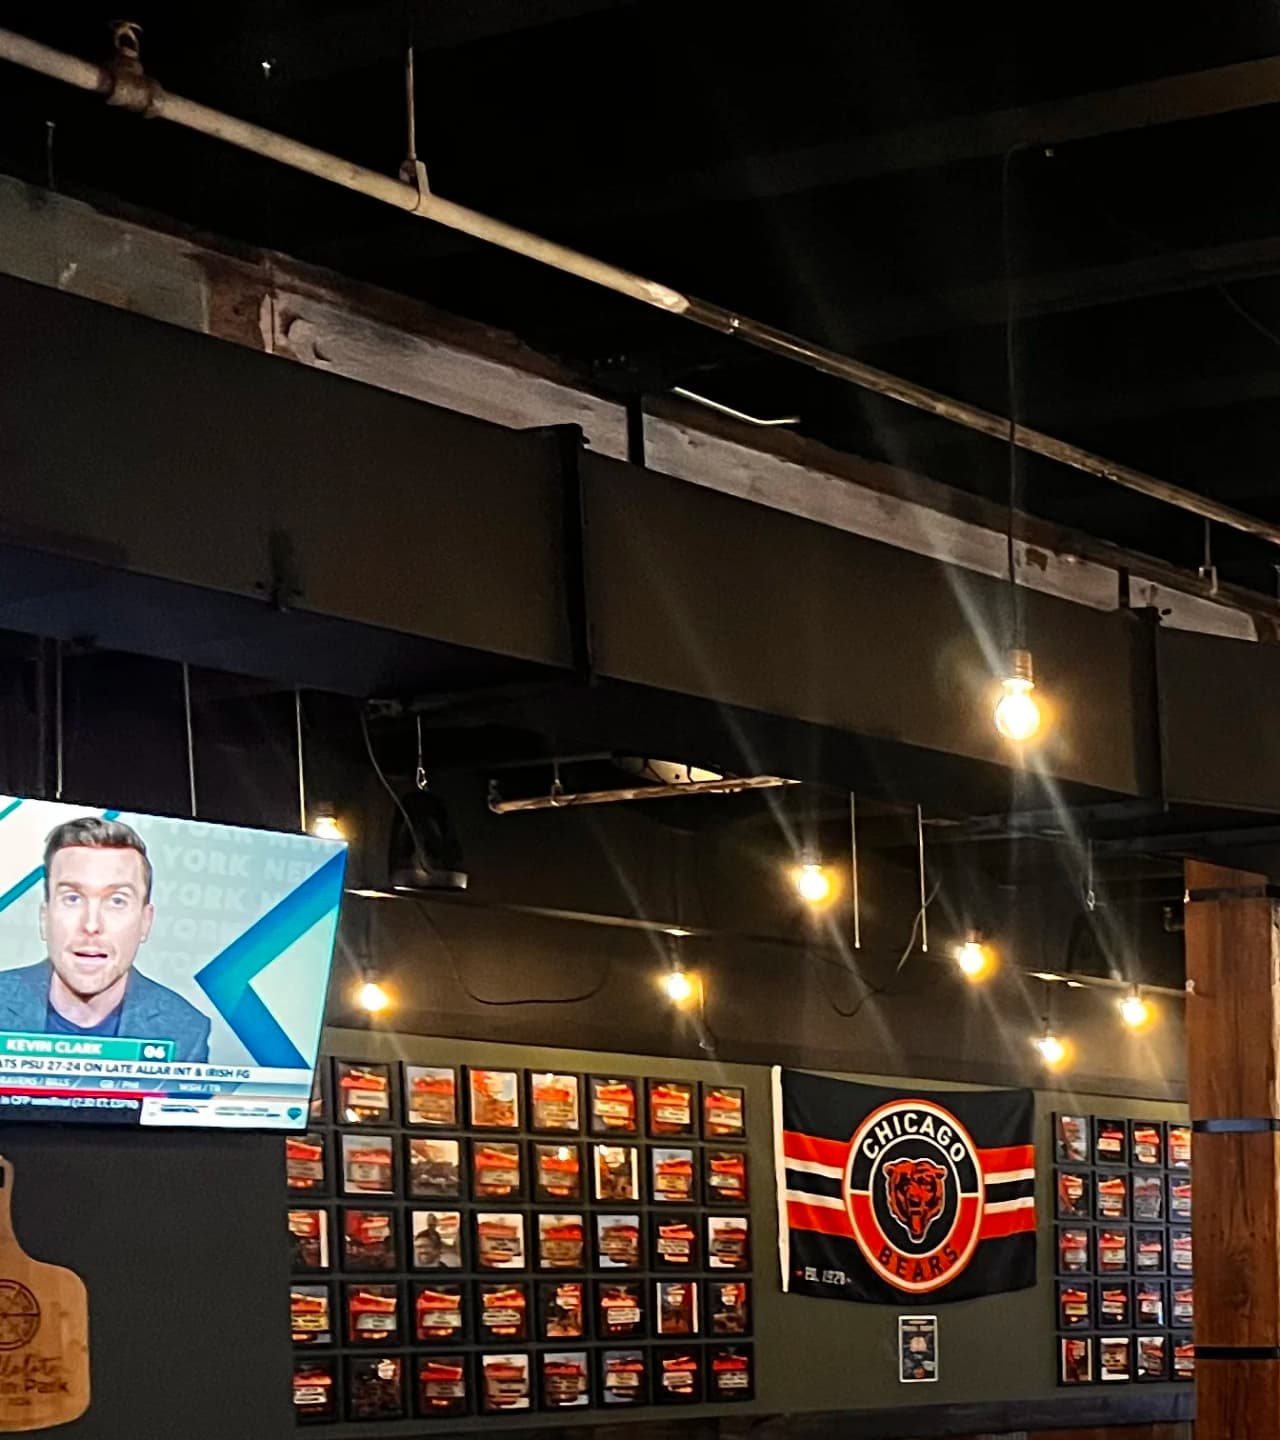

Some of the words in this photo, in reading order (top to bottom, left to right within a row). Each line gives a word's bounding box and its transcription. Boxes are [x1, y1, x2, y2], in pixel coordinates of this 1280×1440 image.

[162, 844, 250, 878] YORK
[159, 880, 246, 911] YORK
[6, 1039, 52, 1052] KEVIN
[54, 1042, 103, 1055] CLARK
[143, 1045, 166, 1059] 06
[20, 1060, 43, 1070] PSU
[47, 1060, 81, 1072] 27-24
[84, 1062, 102, 1073] ON
[105, 1063, 133, 1074] LATE
[136, 1065, 171, 1076] ALLAR
[173, 1066, 191, 1077] INT
[205, 1068, 233, 1079] IRISH
[236, 1070, 250, 1079] FG
[862, 1112, 966, 1163] CHICAGO
[879, 1244, 958, 1282] BEARS
